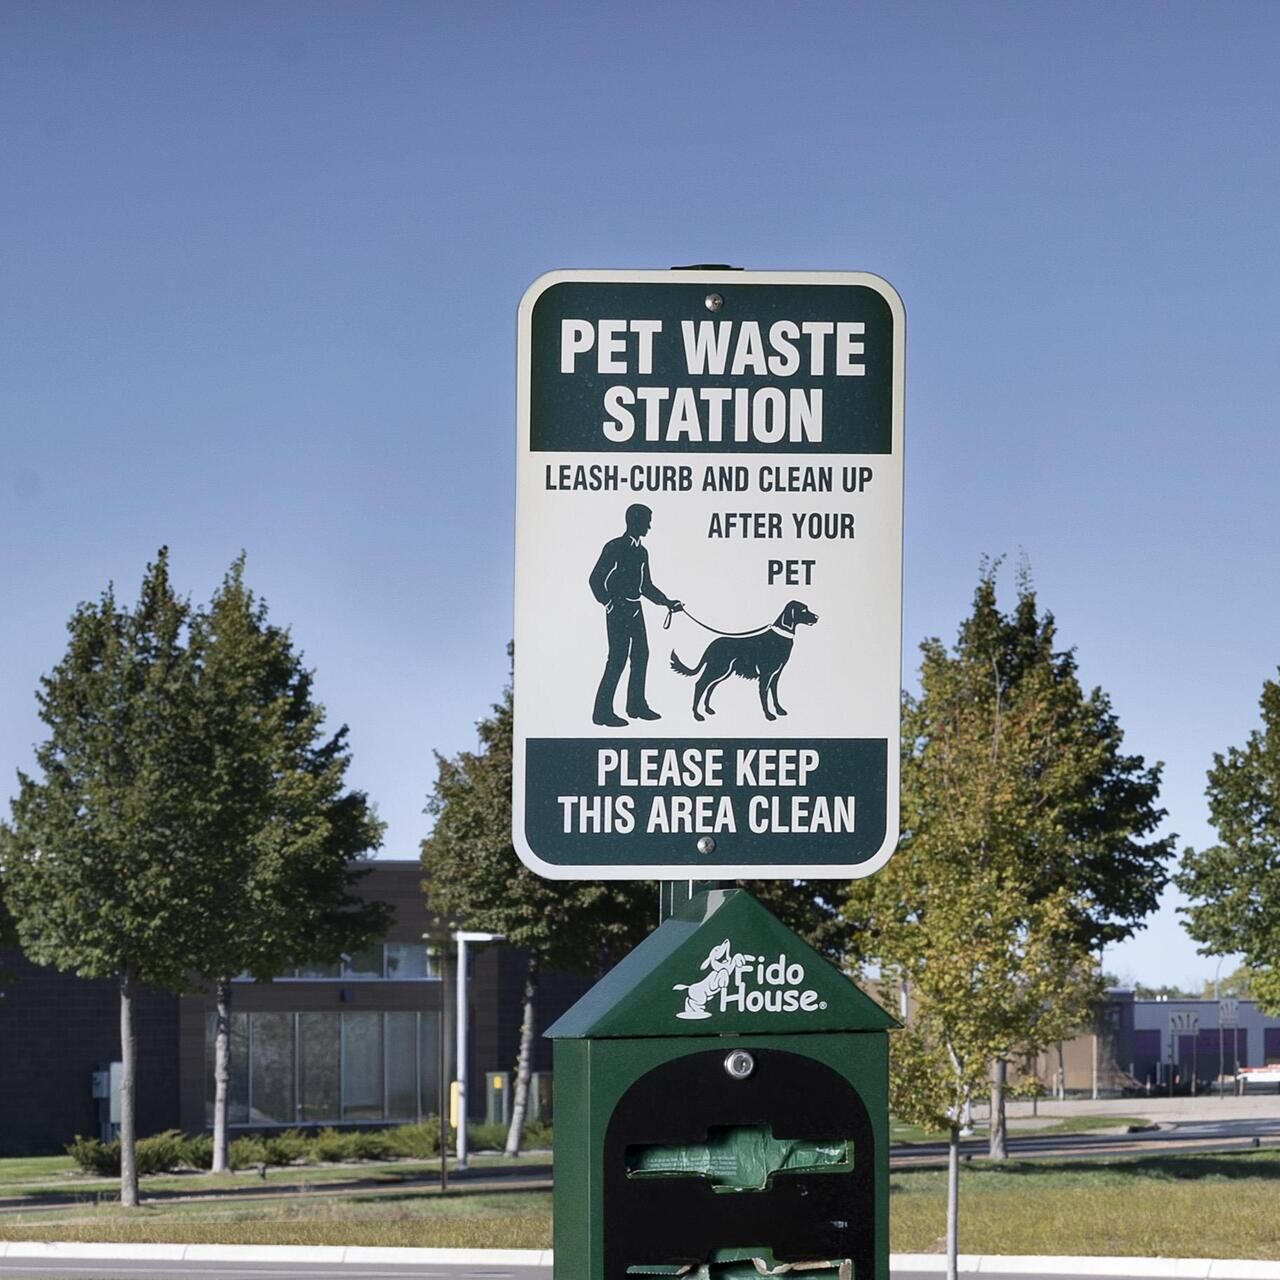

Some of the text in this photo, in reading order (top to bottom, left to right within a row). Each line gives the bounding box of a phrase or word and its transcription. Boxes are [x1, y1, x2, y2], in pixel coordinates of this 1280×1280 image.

[560, 319, 866, 377] PET WASTE
[602, 385, 823, 444] STATION
[545, 464, 873, 493] LEASH-CURB AND CLEAN UP
[707, 512, 855, 540] AFTER YOUR
[767, 559, 817, 586] PET
[597, 748, 820, 787] PLEASE KEEP
[557, 795, 856, 834] THIS AREA CLEAN
[735, 953, 805, 986] Fido
